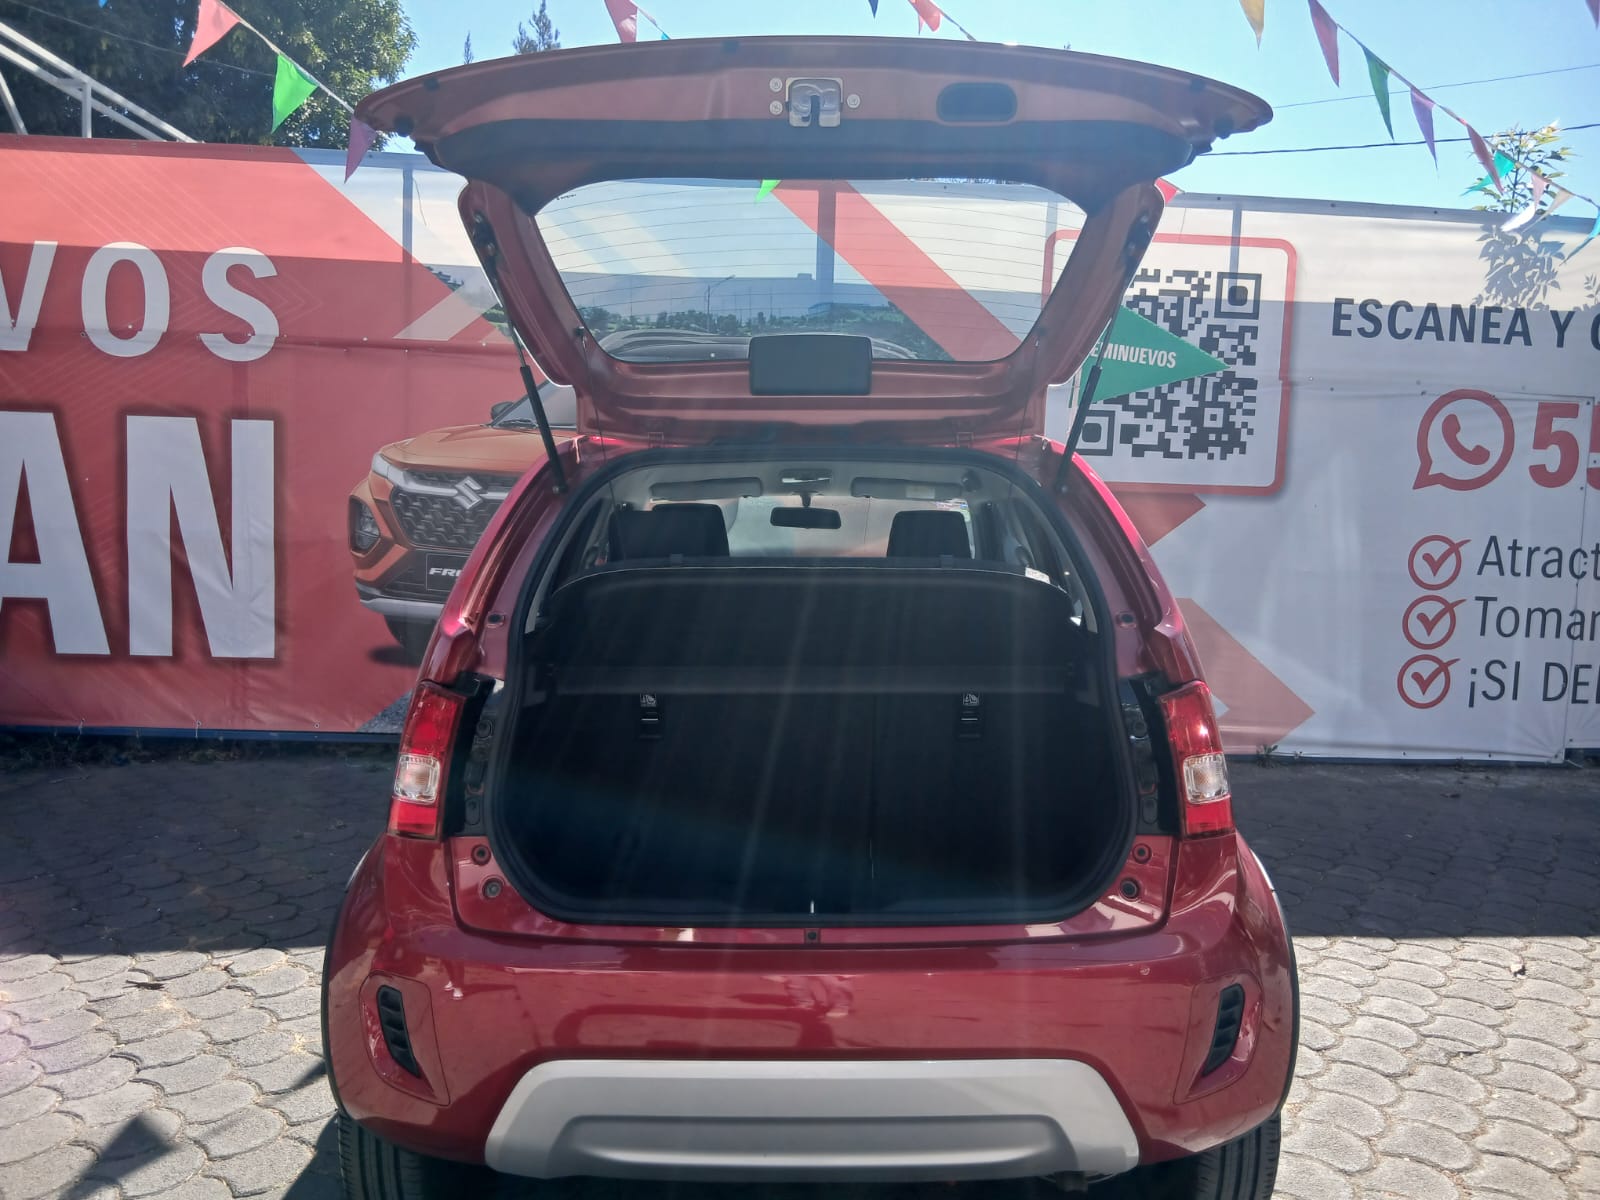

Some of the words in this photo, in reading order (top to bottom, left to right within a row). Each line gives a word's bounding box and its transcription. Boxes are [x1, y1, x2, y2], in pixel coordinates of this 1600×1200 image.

[1332, 297, 1533, 347] ESCANEA
[1550, 310, 1576, 348] Y
[1528, 402, 1600, 490] 5
[0, 410, 275, 658] AN
[1476, 535, 1600, 581] Atract
[1542, 661, 1600, 704] DE
